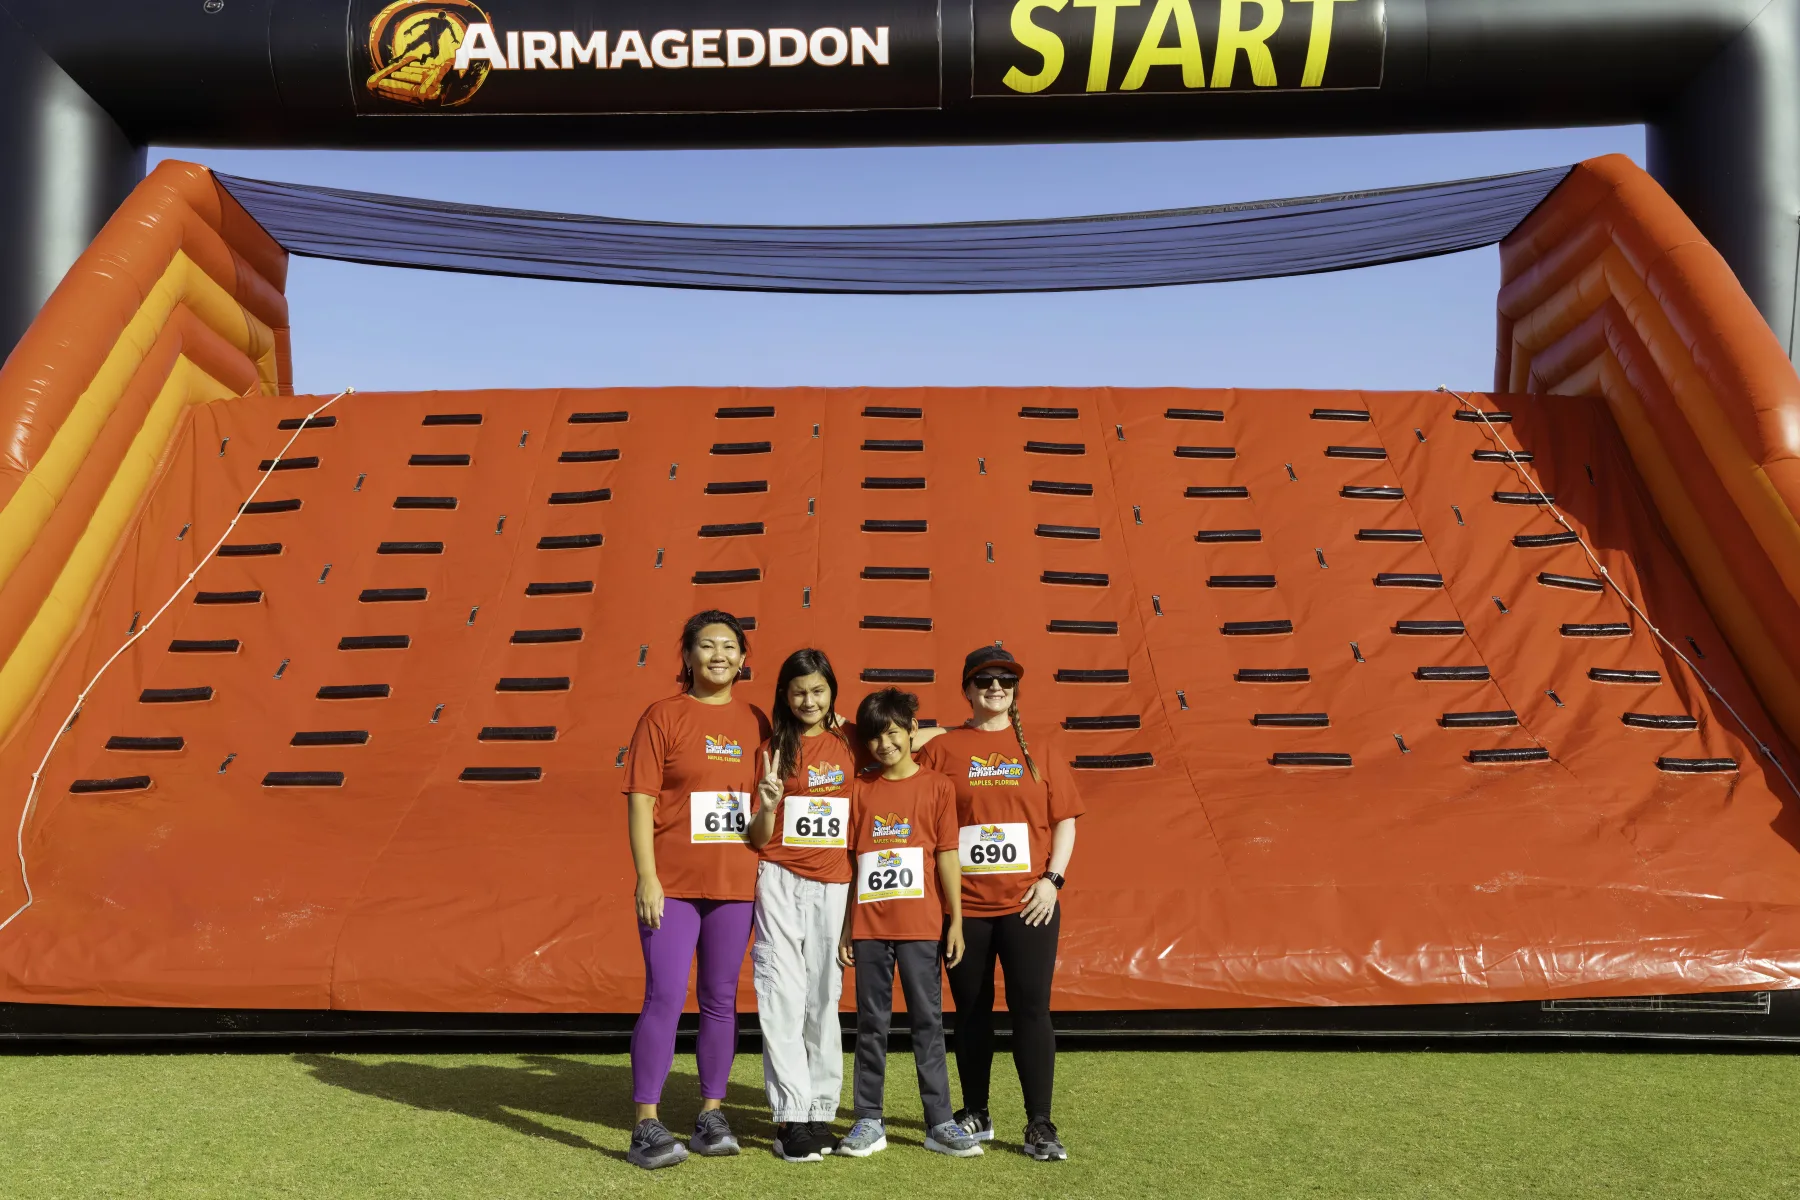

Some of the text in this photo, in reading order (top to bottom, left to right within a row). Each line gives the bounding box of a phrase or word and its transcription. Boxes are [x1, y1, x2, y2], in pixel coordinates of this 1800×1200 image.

[454, 23, 890, 70] AIRMAGEDDON
[1002, 0, 1359, 93] START
[835, 774, 843, 782] 5K
[968, 767, 1021, 778] Inflatable 5K
[704, 811, 746, 833] 619
[795, 816, 841, 837] 618
[970, 843, 1017, 865] 690
[868, 867, 914, 891] 620
